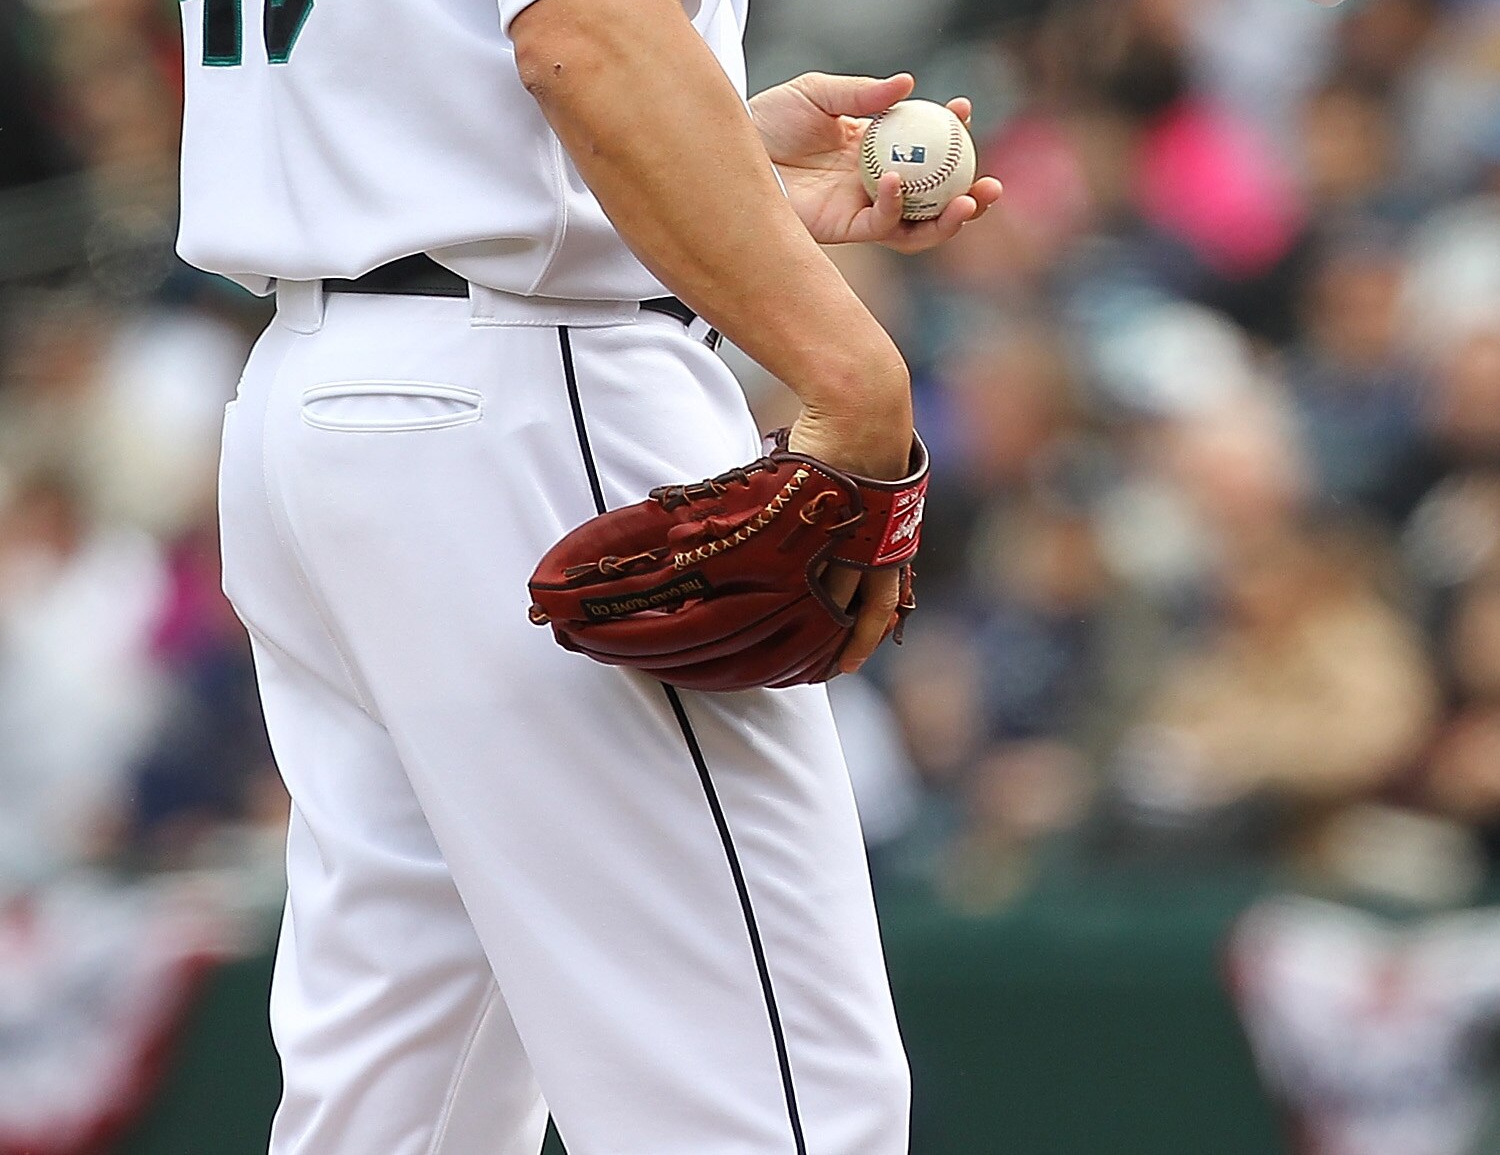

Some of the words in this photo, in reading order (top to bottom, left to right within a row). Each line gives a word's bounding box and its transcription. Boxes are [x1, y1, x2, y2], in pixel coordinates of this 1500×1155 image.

[682, 579, 703, 593] THE
[650, 588, 680, 602] GOLD
[611, 598, 648, 613] GLOVE
